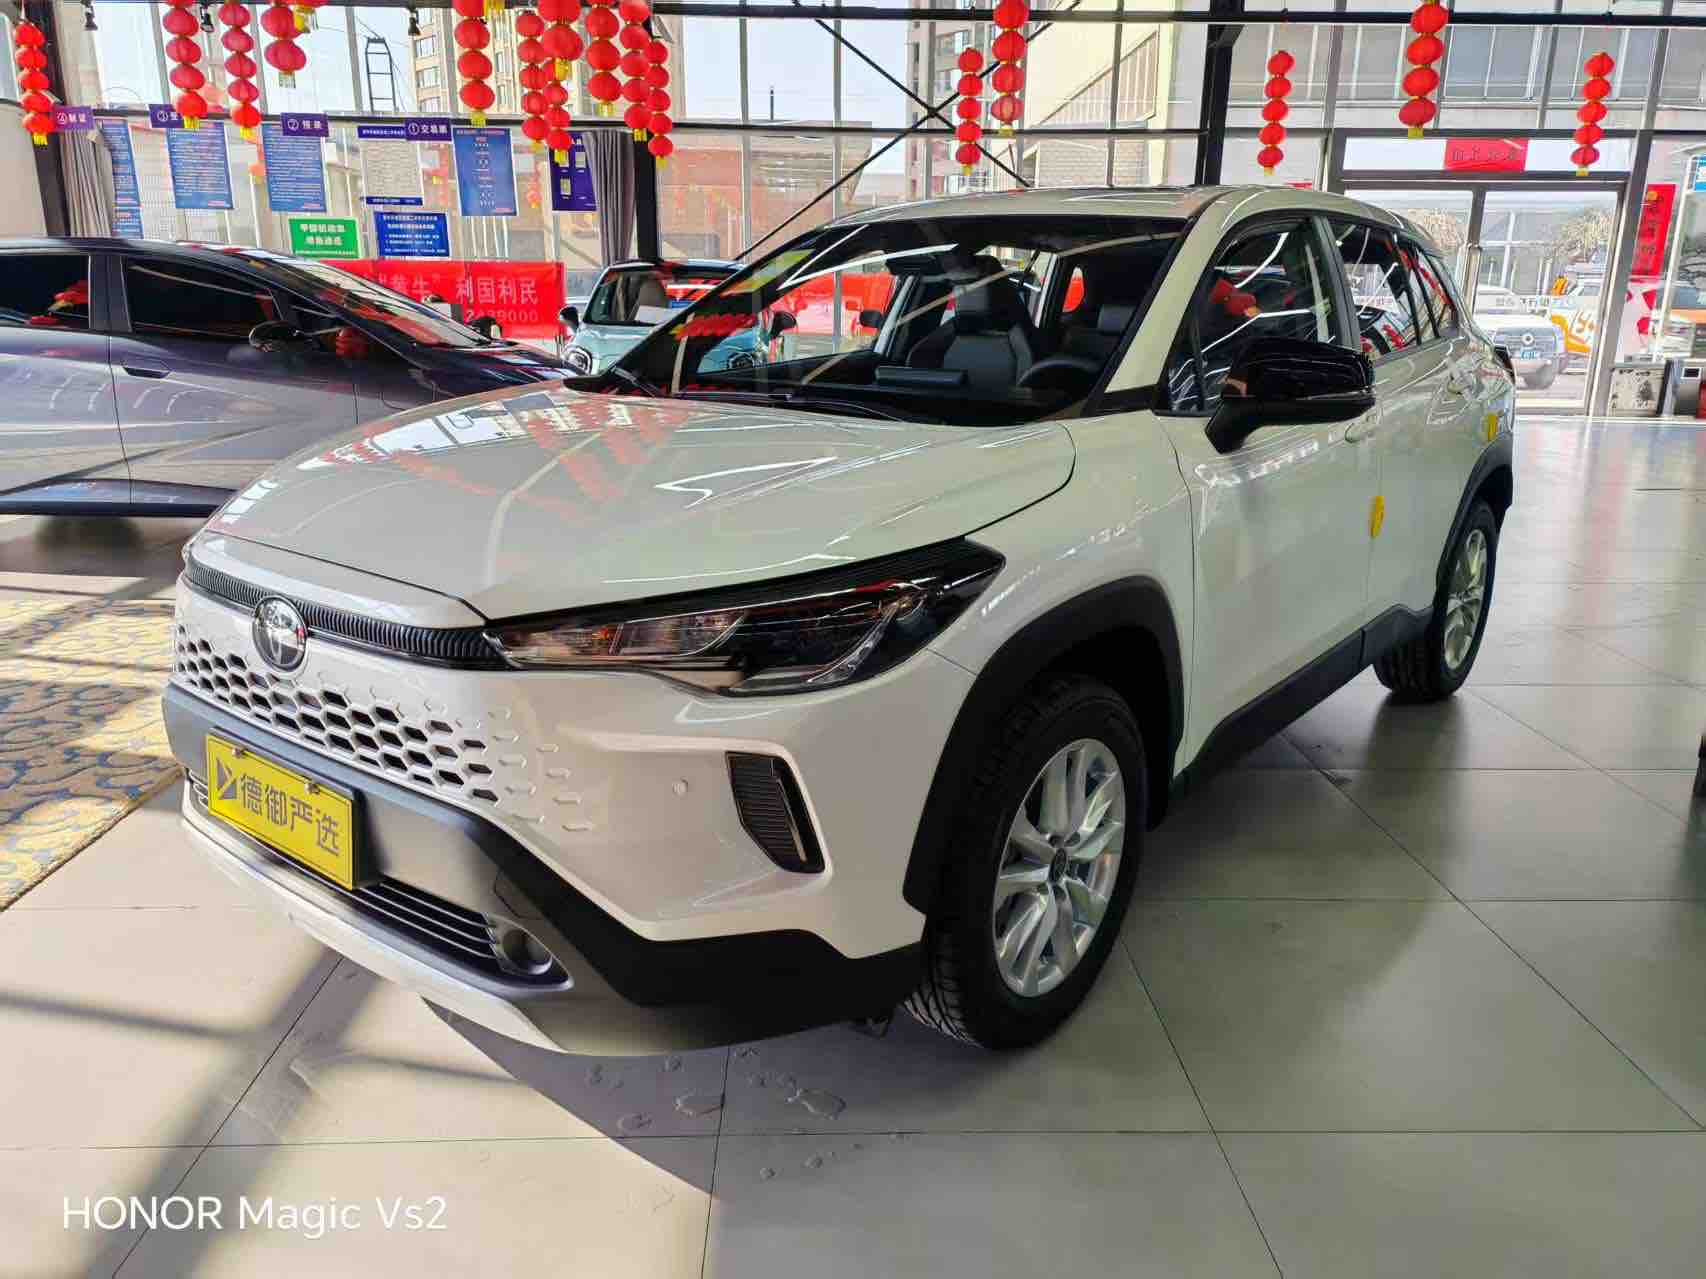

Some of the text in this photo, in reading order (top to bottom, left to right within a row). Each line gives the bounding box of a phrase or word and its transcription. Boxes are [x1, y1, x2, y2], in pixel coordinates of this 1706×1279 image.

[456, 276, 539, 305] 利国利民
[239, 773, 340, 857] 德御严选
